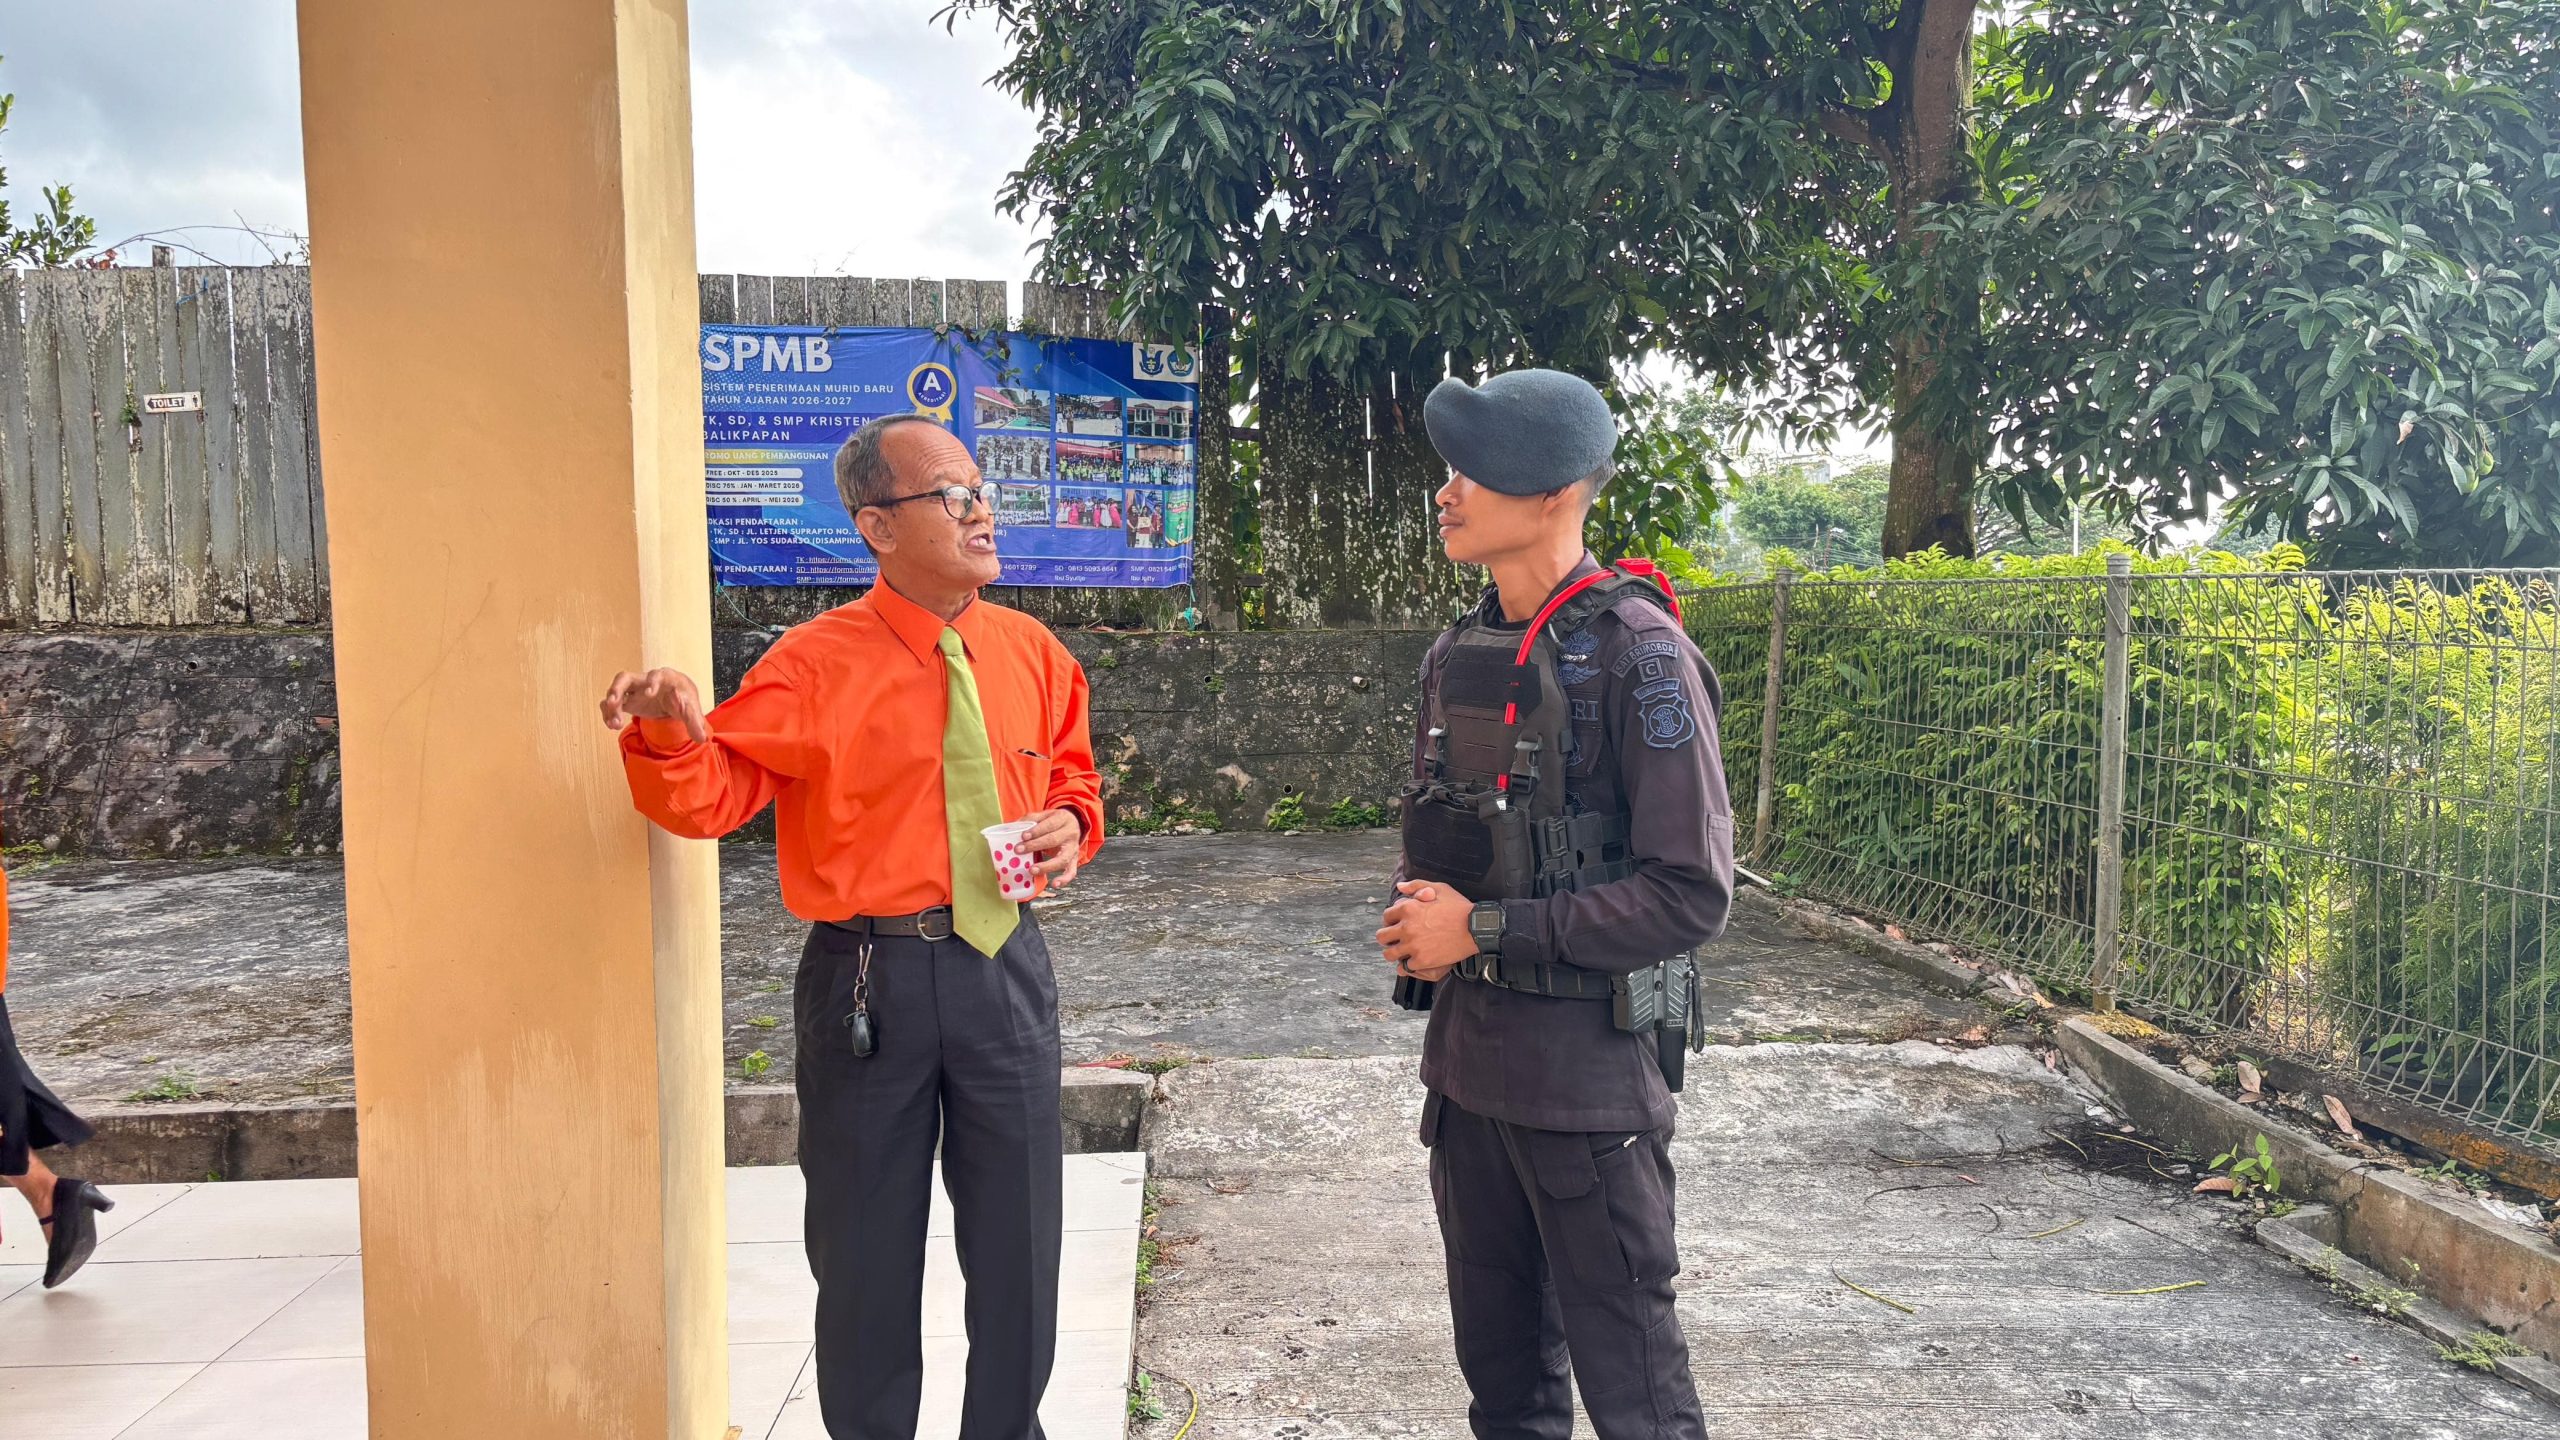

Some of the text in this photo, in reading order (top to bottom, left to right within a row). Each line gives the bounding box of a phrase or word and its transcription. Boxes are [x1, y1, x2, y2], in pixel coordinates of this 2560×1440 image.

[703, 334, 833, 372] SPMB
[922, 371, 942, 391] A
[703, 383, 894, 393] SISTEM PENERIMAAN MURID BARU
[151, 398, 183, 407] TOILET
[704, 395, 852, 405] TAHUN AJARAN 2026-2027
[728, 415, 752, 427] SD,
[758, 416, 767, 426] &
[773, 416, 804, 426] SMP
[810, 416, 870, 426] KRISTEN
[703, 430, 790, 441] BALIKPAPAN
[733, 452, 758, 460] UANG
[760, 452, 829, 460] PEMBANGUNAN
[735, 518, 798, 526] PENDAFTARAN
[714, 537, 730, 545] SMP
[751, 537, 768, 545] YOS
[770, 537, 810, 545] SUDARSO
[724, 565, 788, 573] PENDAFTARAN
[1615, 642, 1674, 673] SAT BRIMOBDA
[1645, 663, 1657, 675] C
